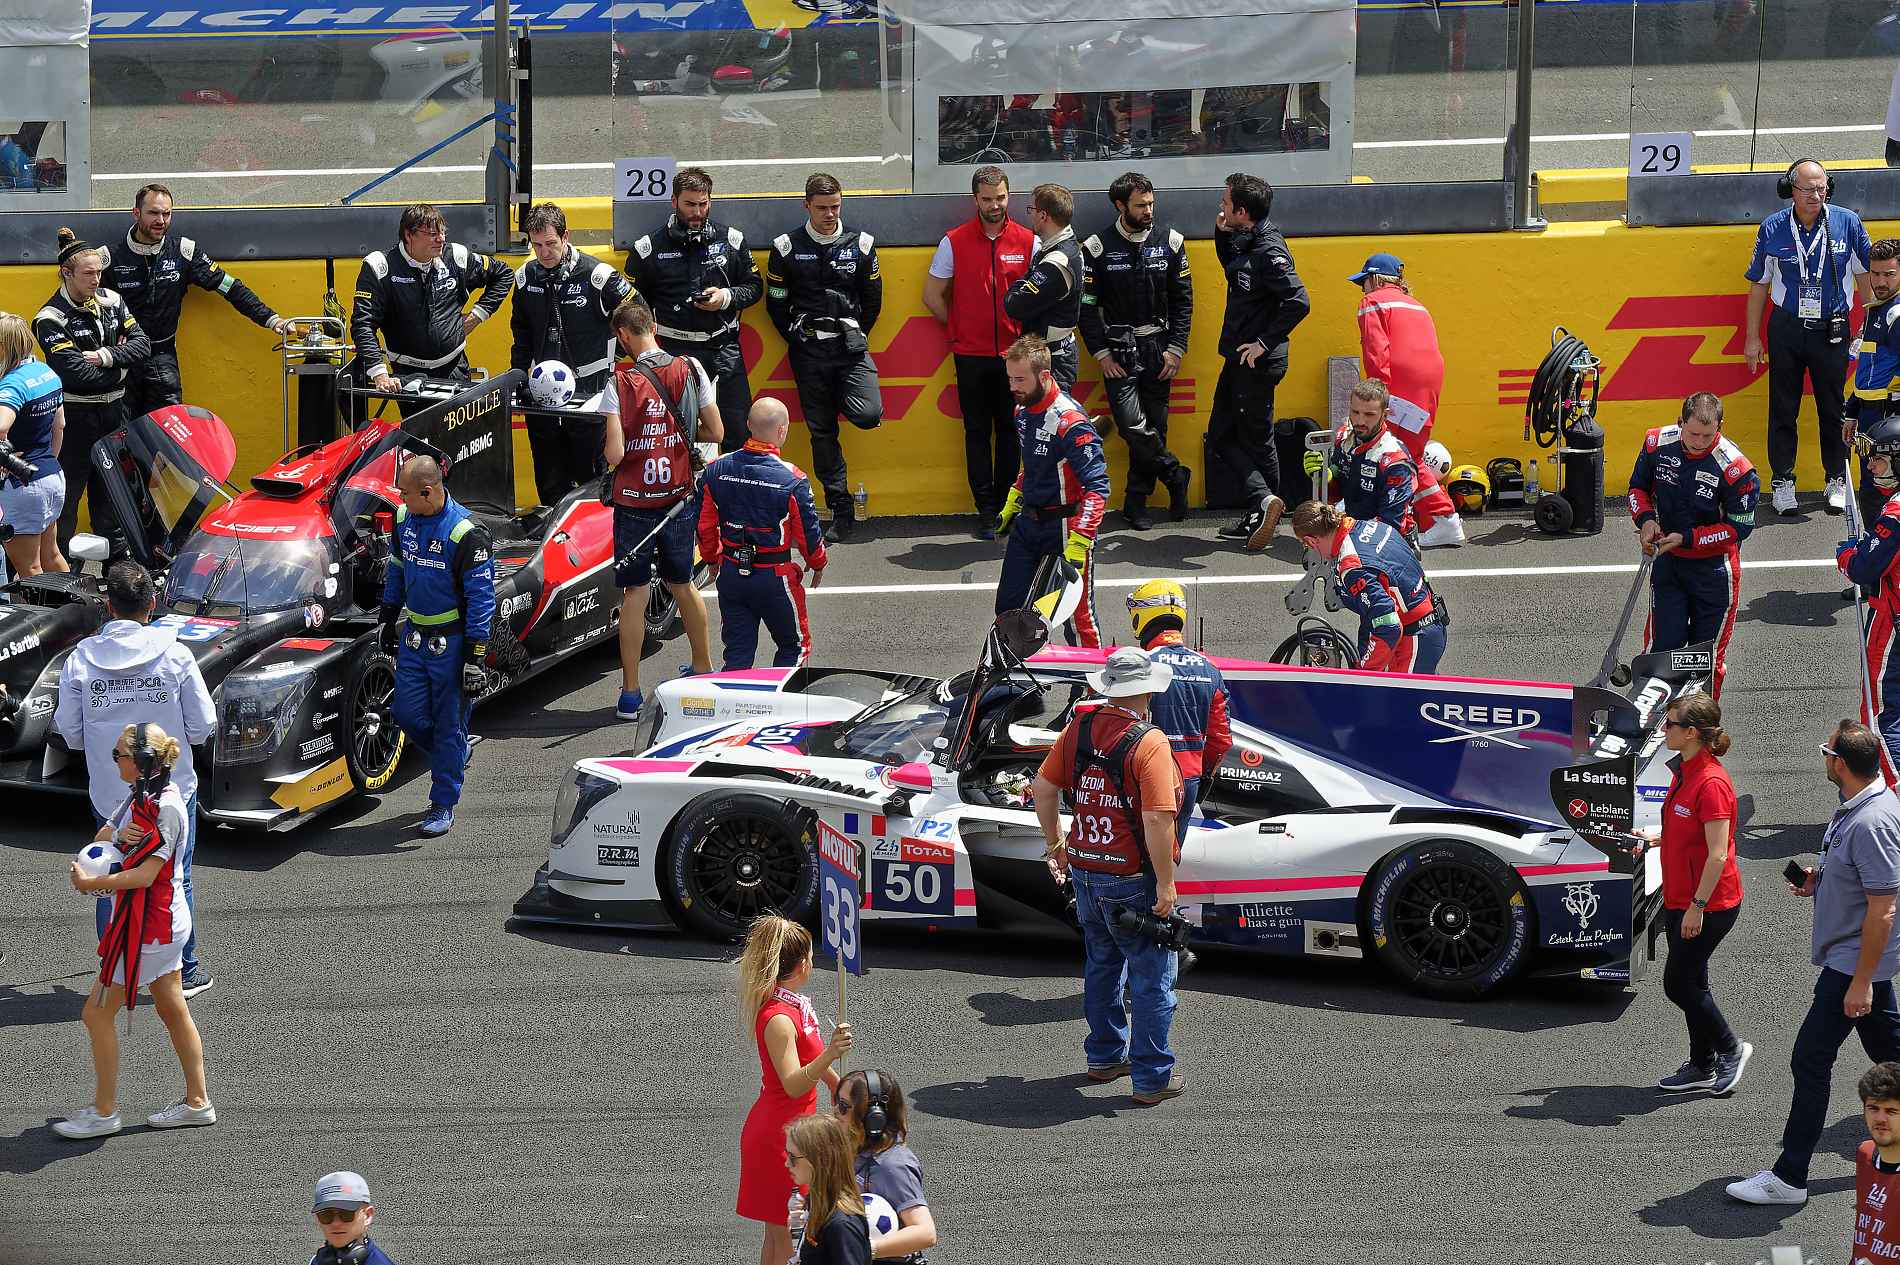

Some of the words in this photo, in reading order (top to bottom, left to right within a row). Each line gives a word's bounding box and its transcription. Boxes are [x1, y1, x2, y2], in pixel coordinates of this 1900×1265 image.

[1640, 145, 1682, 173] 29
[626, 169, 667, 197] 28
[643, 456, 671, 485] 86
[10, 633, 40, 656] Sarthe
[1420, 702, 1541, 733] CREED
[1471, 740, 1489, 748] 1760
[1220, 766, 1282, 782] PRIMAGAZ
[1563, 770, 1580, 782] La
[1582, 771, 1627, 785] Sarthe
[1238, 782, 1262, 791] NEXT
[1590, 803, 1630, 815] Leblanc
[593, 824, 641, 835] NATURAL
[919, 819, 953, 839] P2
[1075, 813, 1115, 845] 133
[1602, 829, 1625, 837] LOGIS
[821, 828, 858, 876] MOTUL
[873, 839, 899, 851] 24h
[904, 844, 951, 857] TOTAL
[885, 863, 941, 904] 50
[1374, 858, 1408, 921] MICHELIN
[826, 876, 856, 960] 33
[1240, 903, 1294, 918] Juliette
[1247, 917, 1268, 928] has
[1279, 917, 1302, 929] gun
[1594, 928, 1624, 943] Parfum
[1870, 1238, 1900, 1260] TRAC
